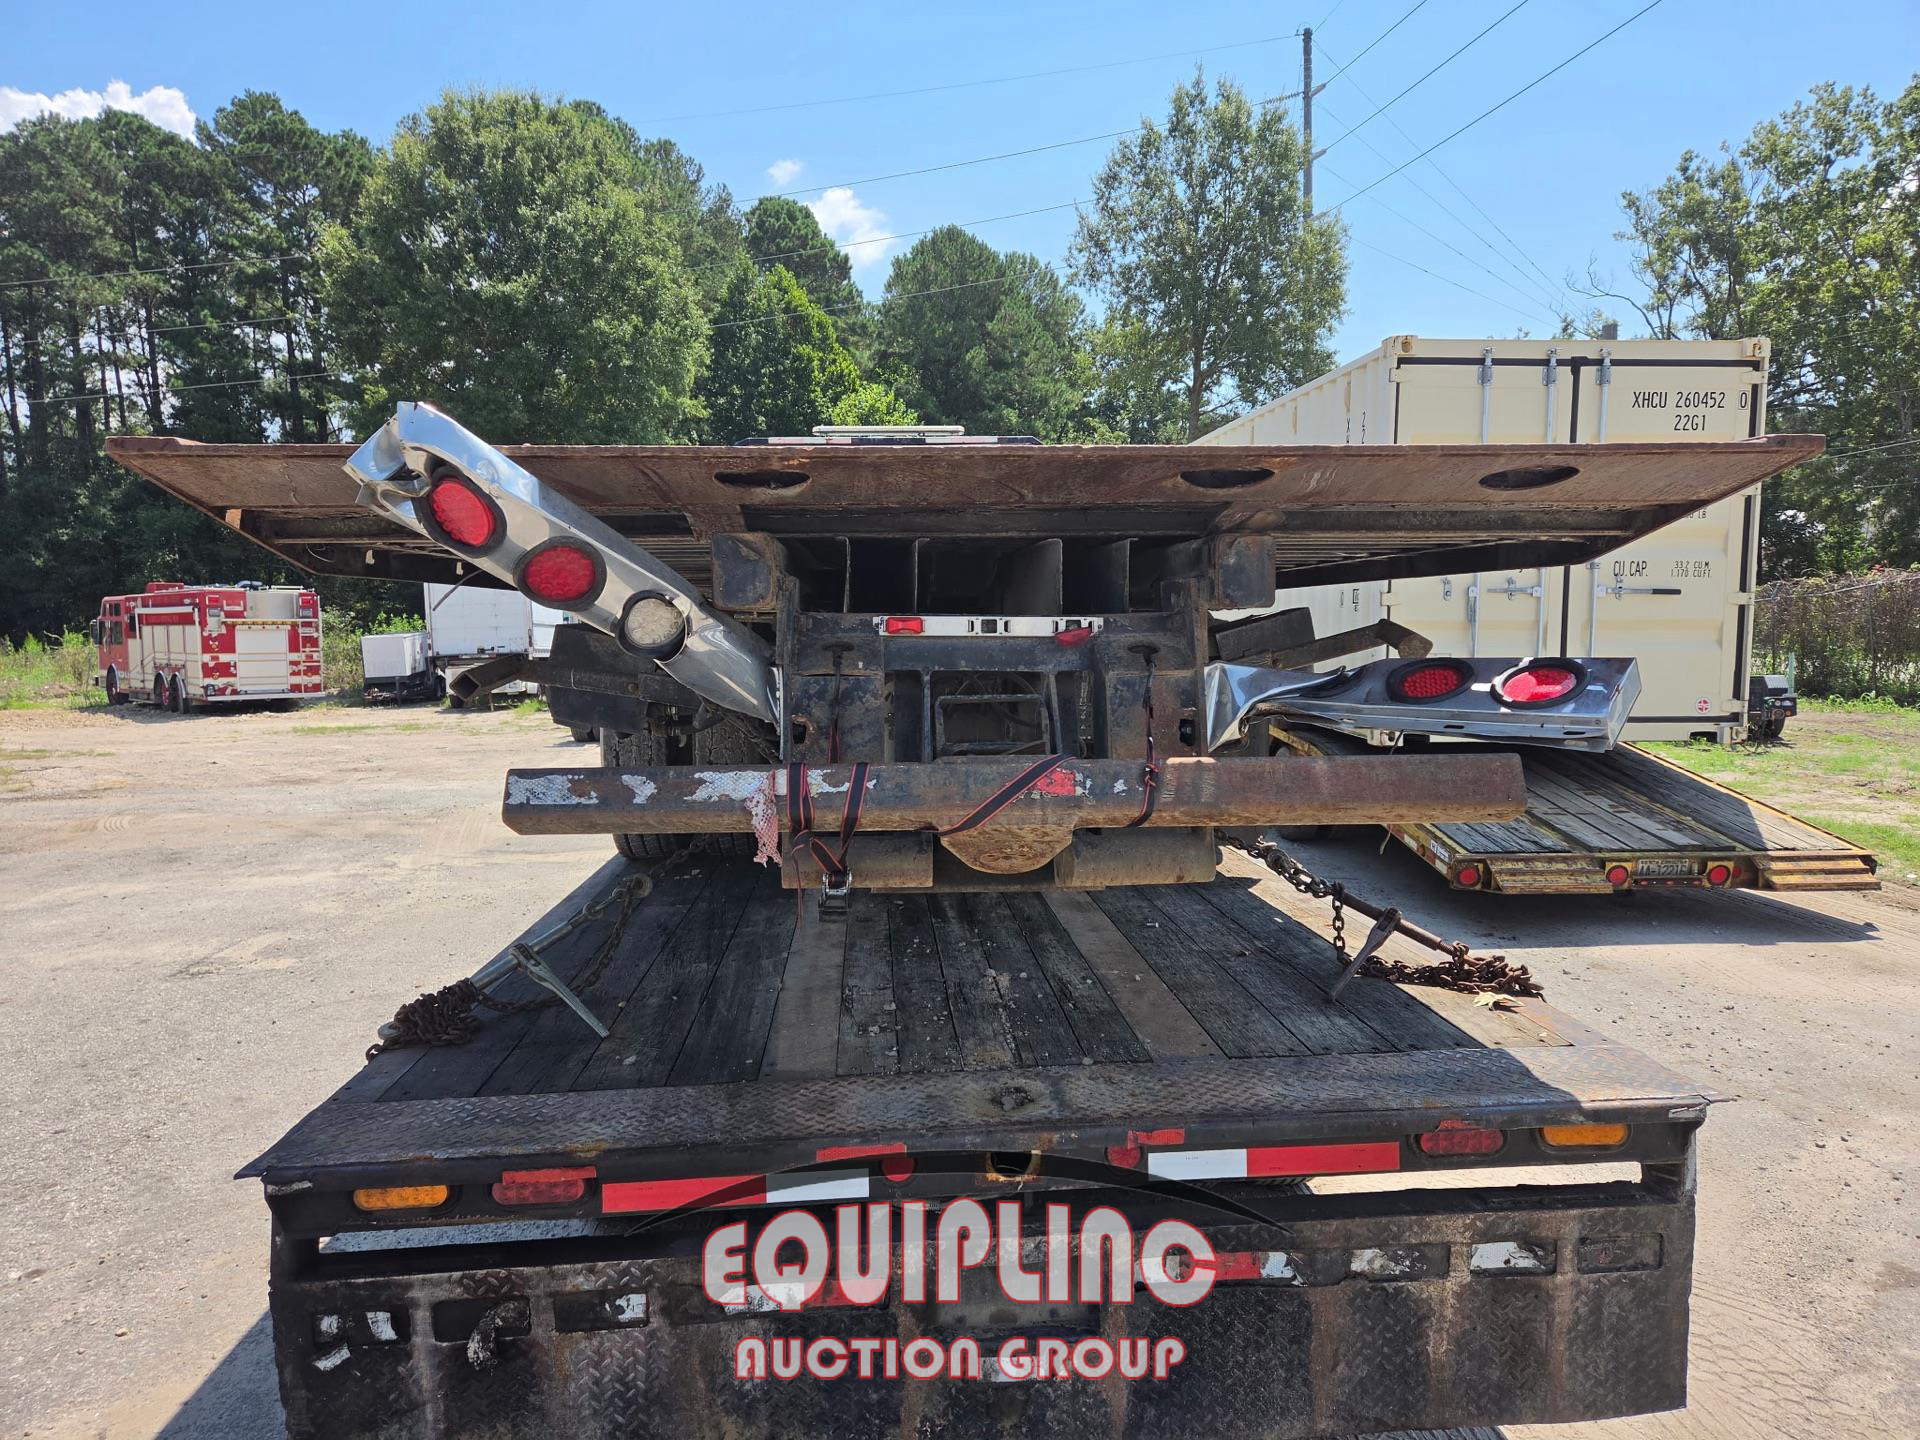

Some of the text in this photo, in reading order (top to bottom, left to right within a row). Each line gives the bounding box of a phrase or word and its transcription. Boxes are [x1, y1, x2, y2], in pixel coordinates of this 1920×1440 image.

[1632, 391, 1748, 409] XHCU 260452 0
[1673, 414, 1706, 431] 22G1
